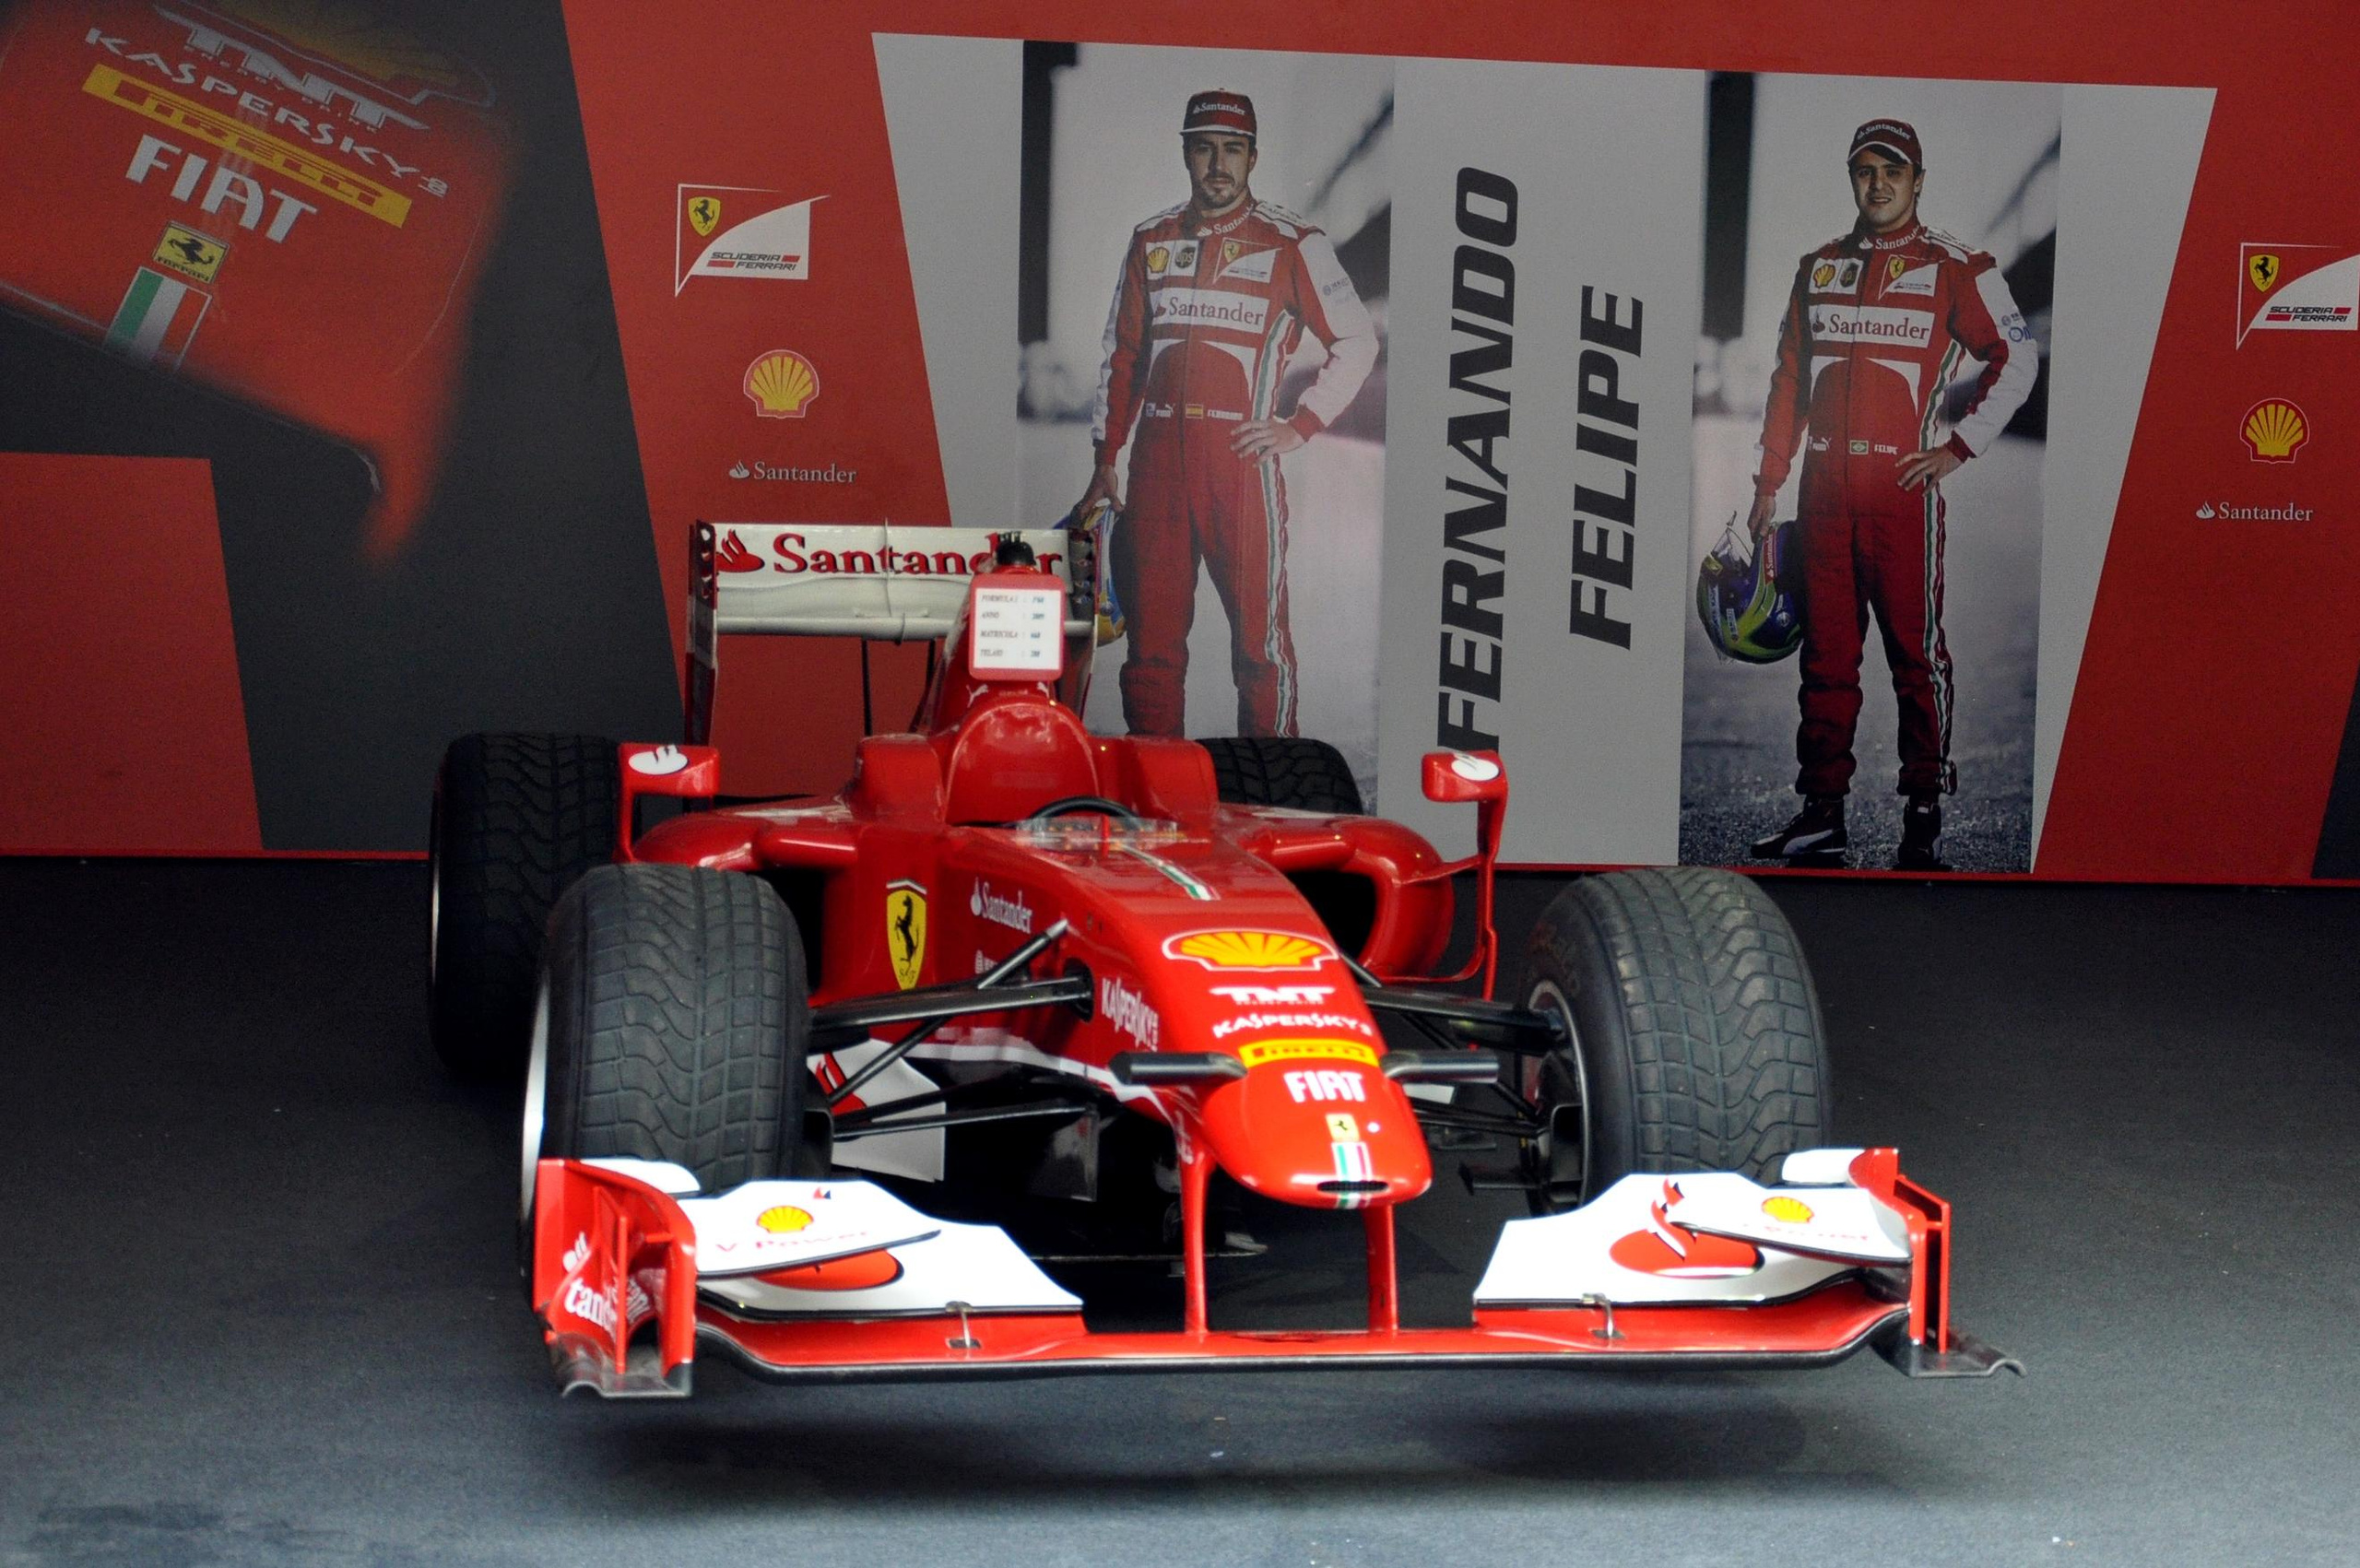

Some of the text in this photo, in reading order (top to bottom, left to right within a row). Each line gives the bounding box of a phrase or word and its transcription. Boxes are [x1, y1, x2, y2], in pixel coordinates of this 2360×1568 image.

[152, 4, 430, 130] TNT
[85, 28, 420, 179] KASPERSKY
[1201, 102, 1245, 116] Santander
[1865, 124, 1911, 140] Santander
[125, 134, 317, 243] FIAT
[711, 252, 781, 262] SCUDERIA
[736, 262, 796, 271] FERRARI
[1169, 297, 1264, 324] Santander
[2269, 306, 2333, 314] SCUDERIA
[2292, 314, 2348, 323] FERRARI
[1829, 314, 1929, 340] Santander
[753, 462, 856, 483] Santander
[1437, 166, 1518, 754] FERNANDO
[1569, 285, 1643, 651] FELIPE
[2219, 502, 2313, 521] Santander
[773, 532, 1062, 574] Santandr
[983, 881, 1032, 934] Santander
[1210, 985, 1335, 1003] TNT
[1212, 1012, 1358, 1039] KASPERSKY
[1283, 1070, 1366, 1102] FIAT
